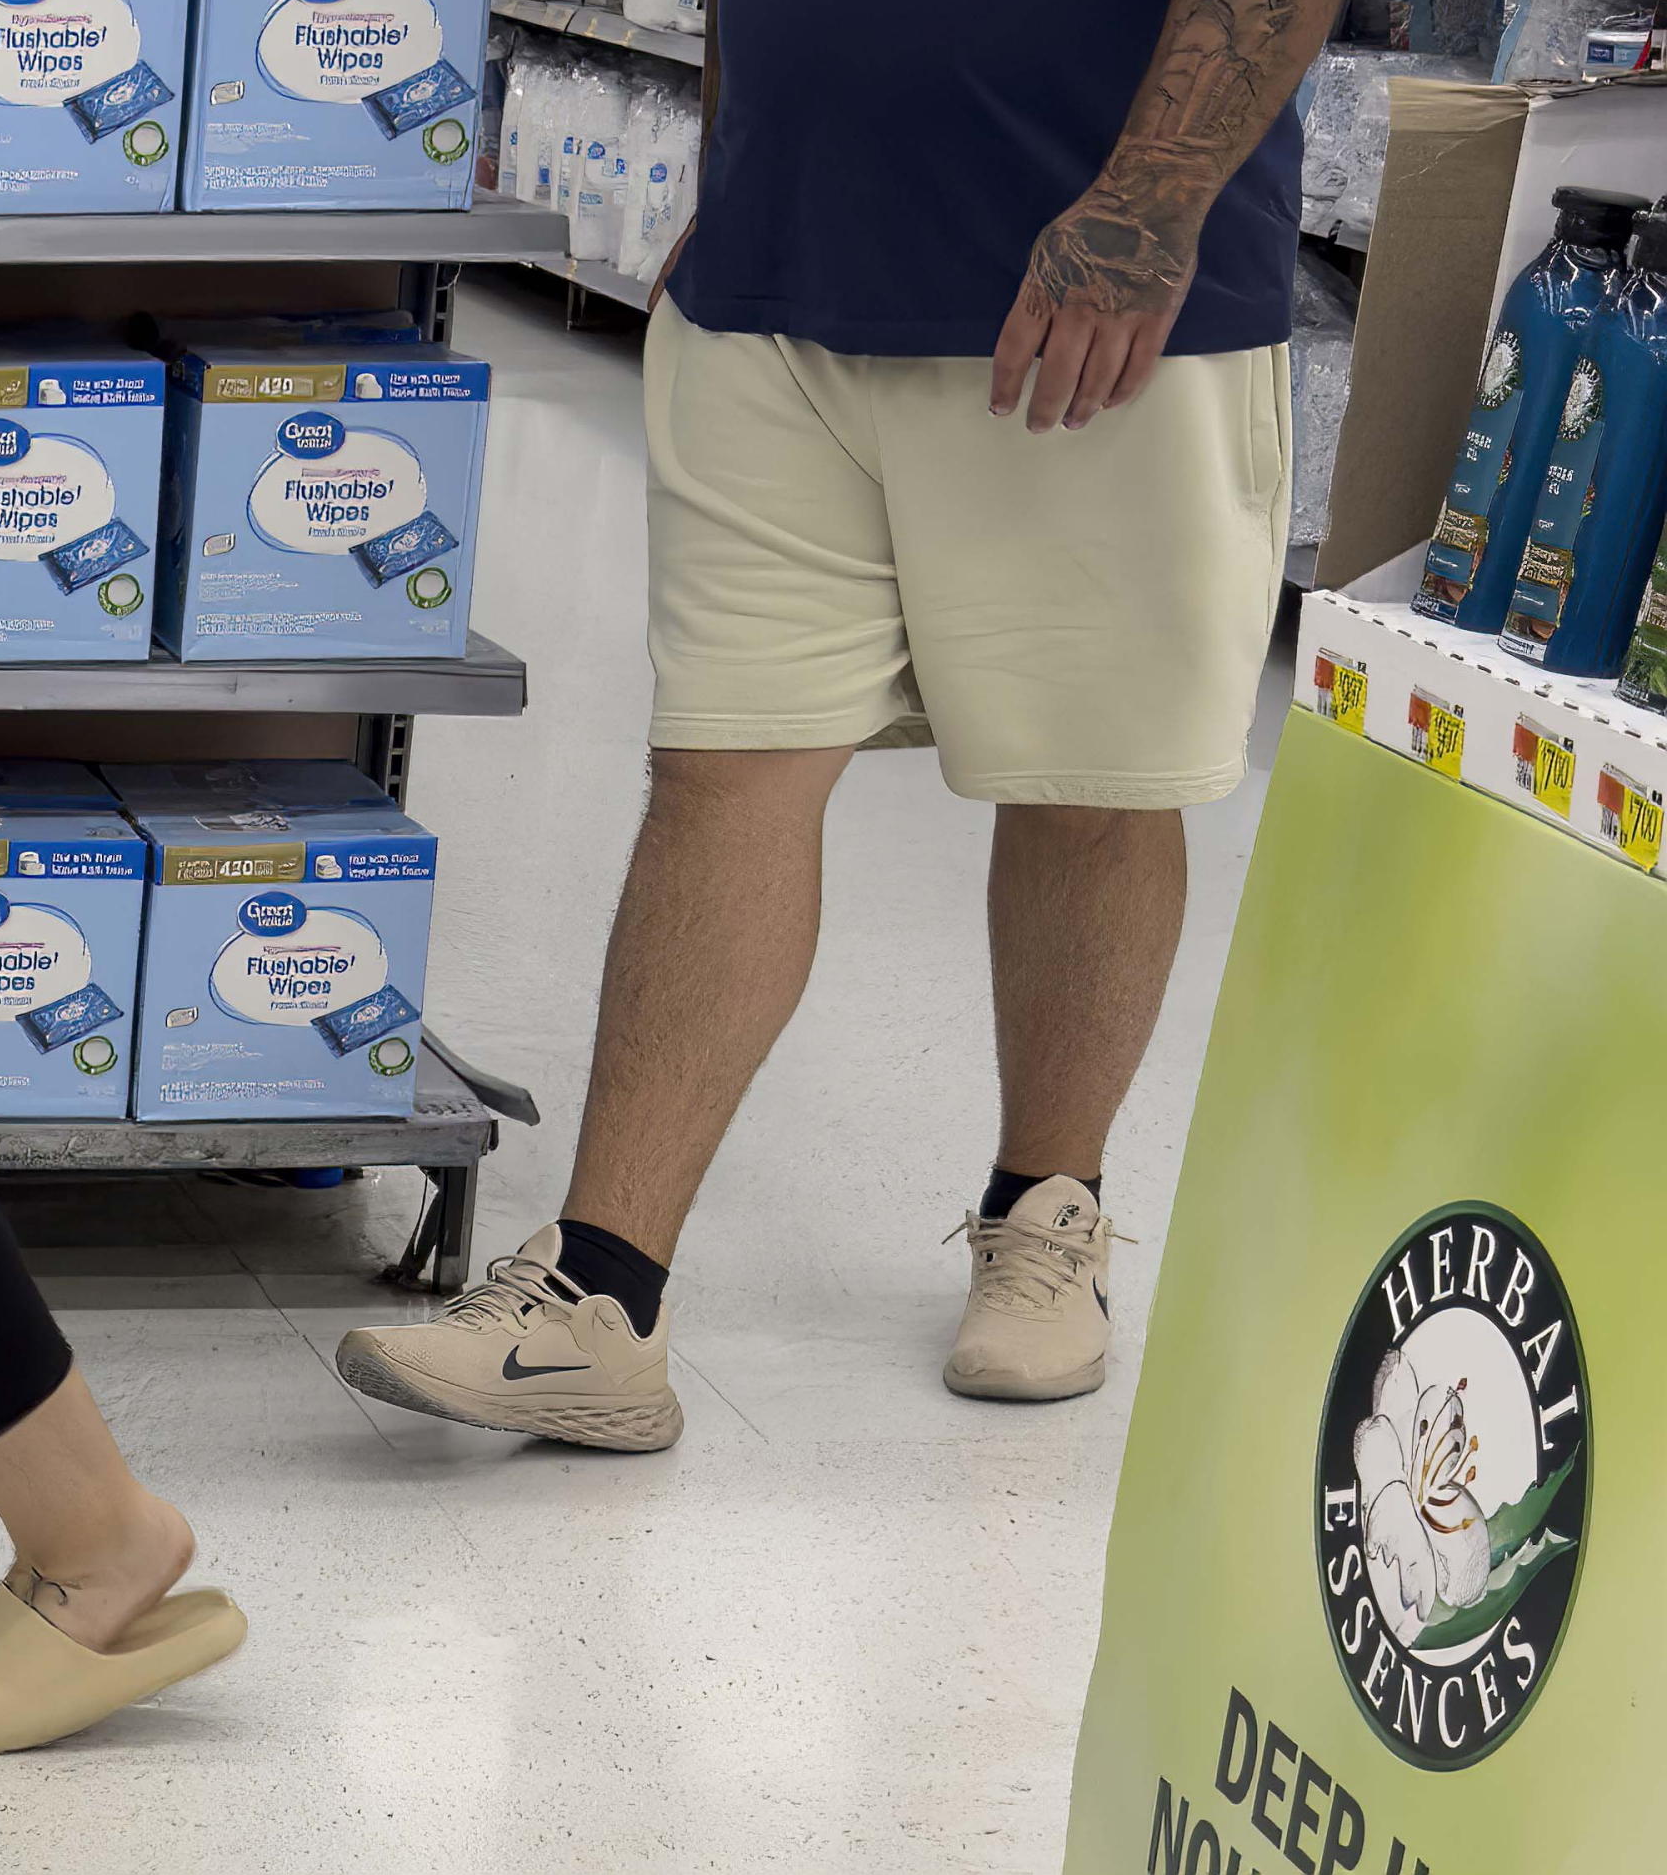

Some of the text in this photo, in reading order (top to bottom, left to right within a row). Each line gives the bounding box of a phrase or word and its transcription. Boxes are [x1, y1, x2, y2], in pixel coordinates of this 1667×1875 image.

[17, 50, 83, 72] Wipes
[316, 47, 383, 72] Wipes
[306, 501, 370, 523] Wipes
[268, 977, 332, 997] Wipes
[1380, 1224, 1580, 1453] HERBAL
[1323, 1480, 1537, 1751] ESSENCES
[1214, 1685, 1366, 1875] DEEP
